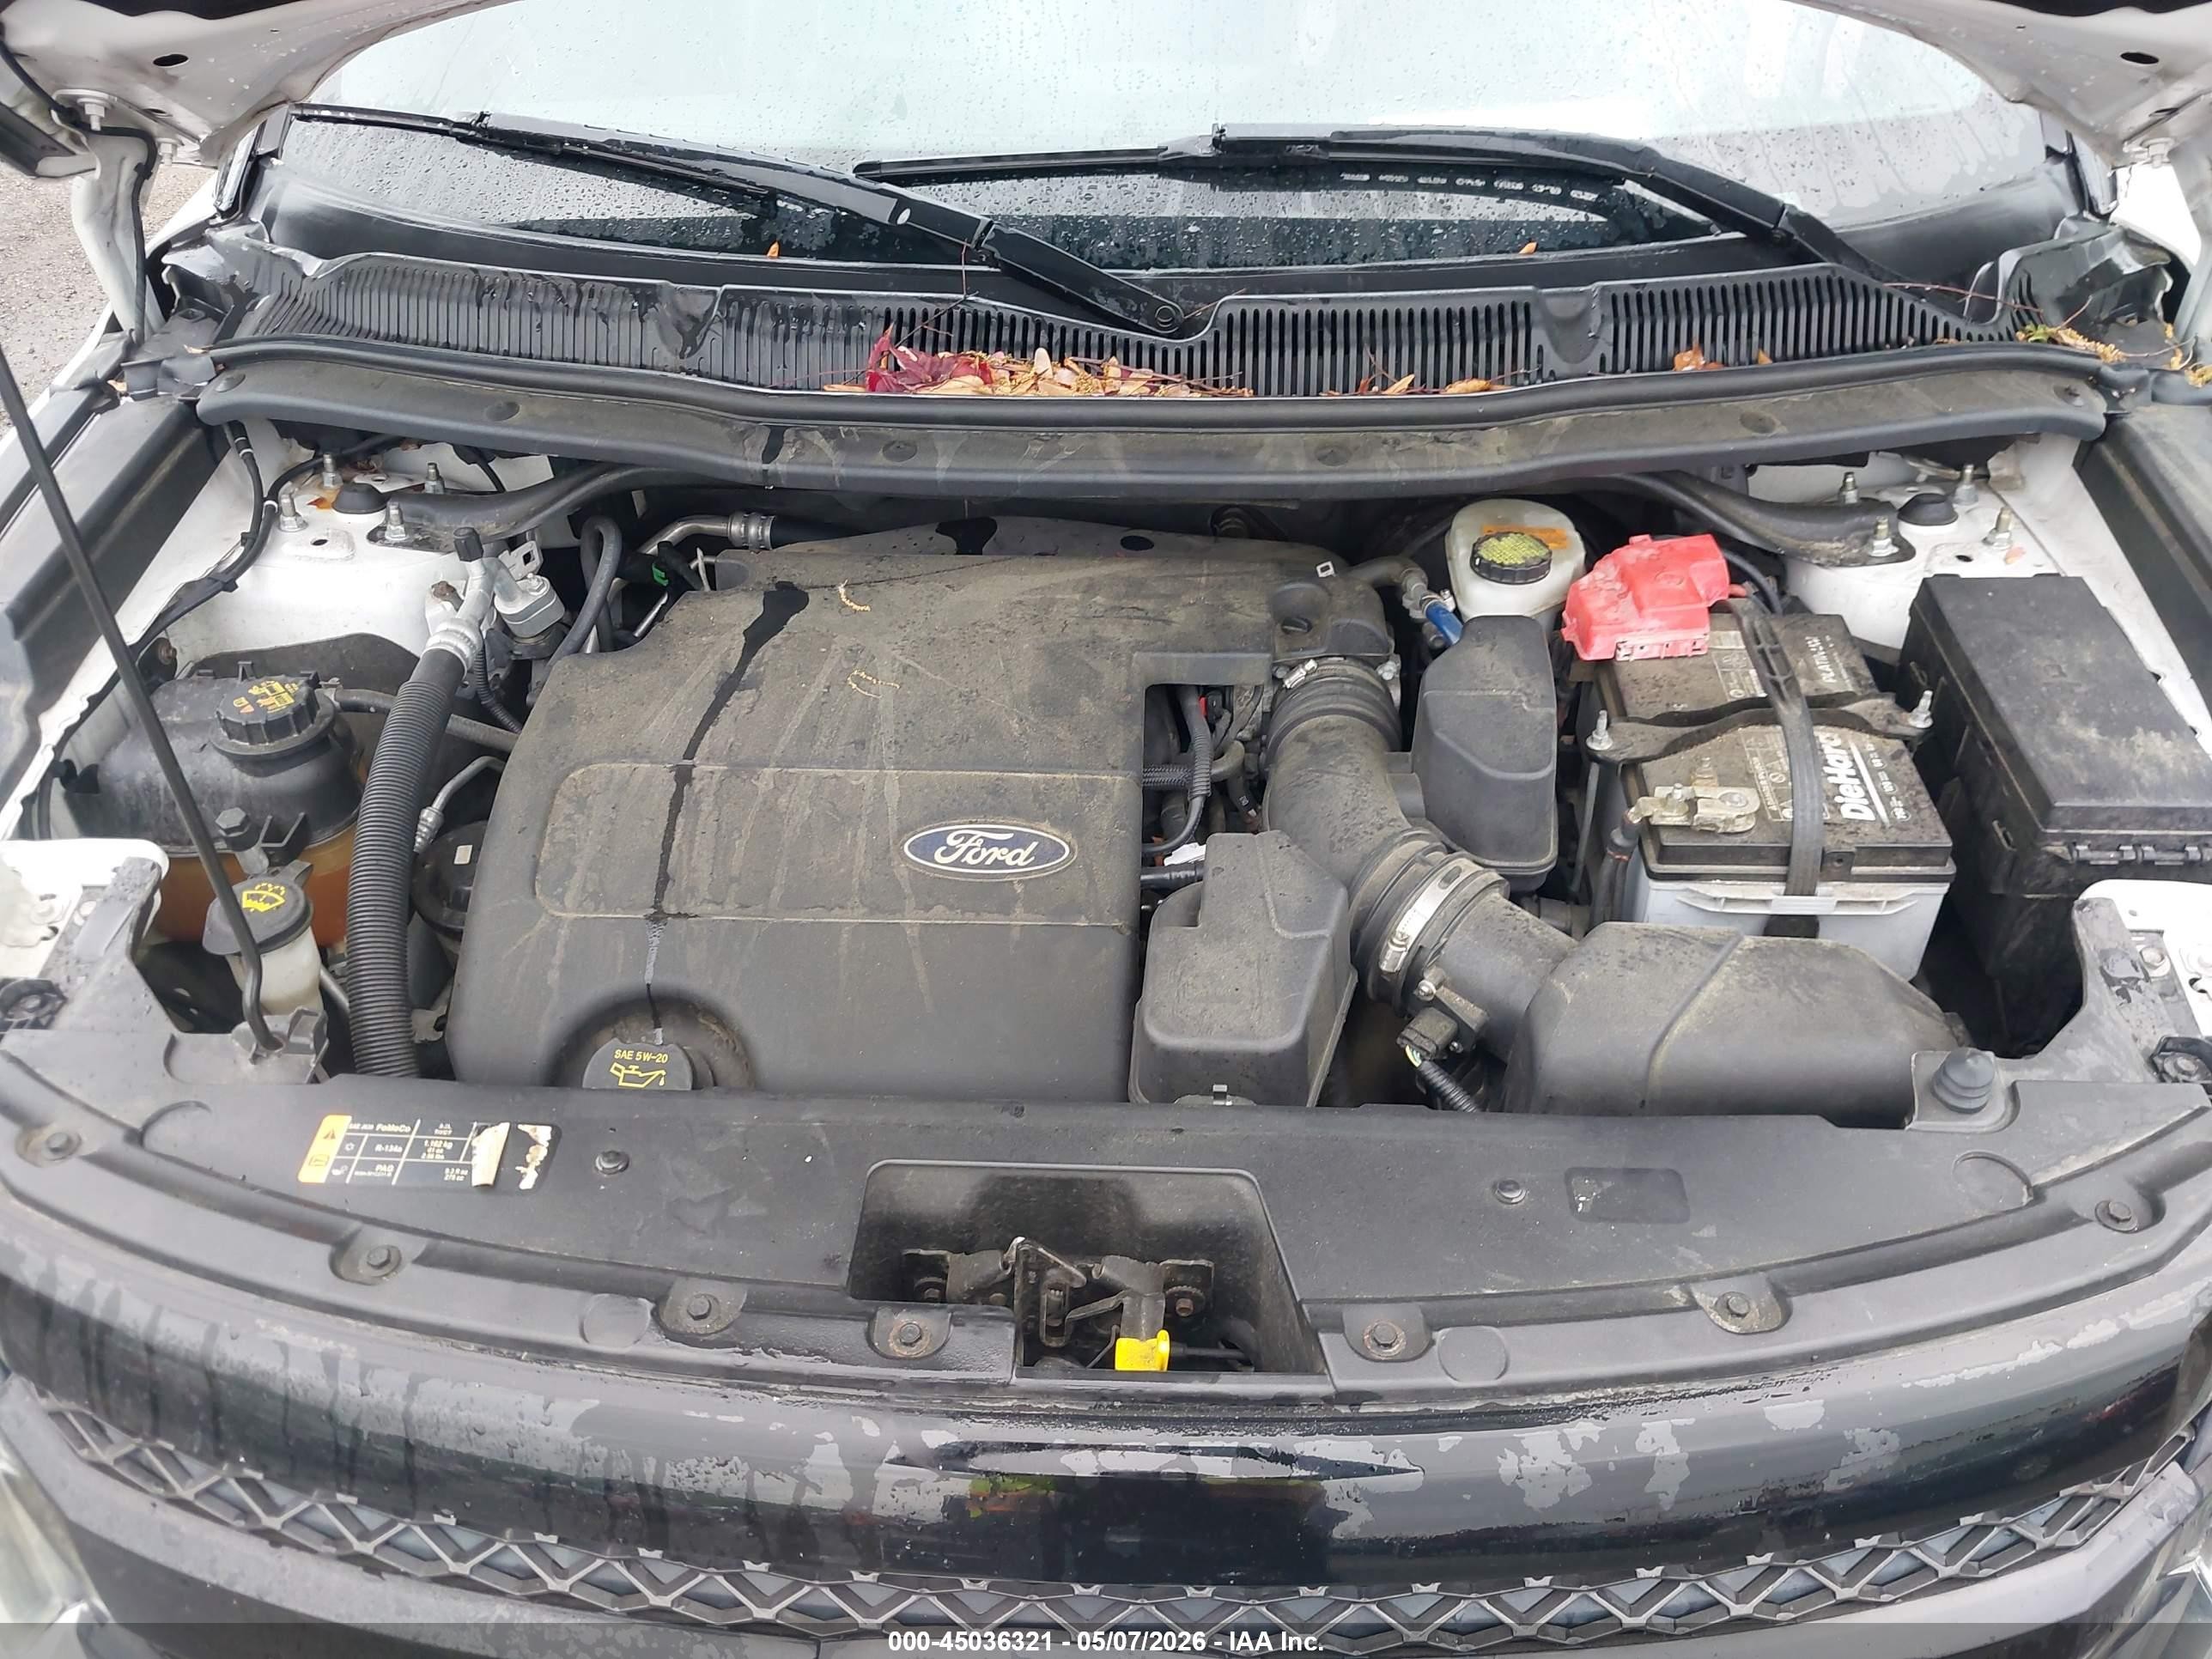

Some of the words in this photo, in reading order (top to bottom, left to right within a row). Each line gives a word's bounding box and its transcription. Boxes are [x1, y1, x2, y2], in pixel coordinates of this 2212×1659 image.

[1814, 728, 1875, 821] DieHard
[933, 829, 1039, 867] Ford
[614, 1049, 635, 1060] SAE
[635, 1050, 669, 1064] 5W-20
[375, 1123, 411, 1133] FoMoCo
